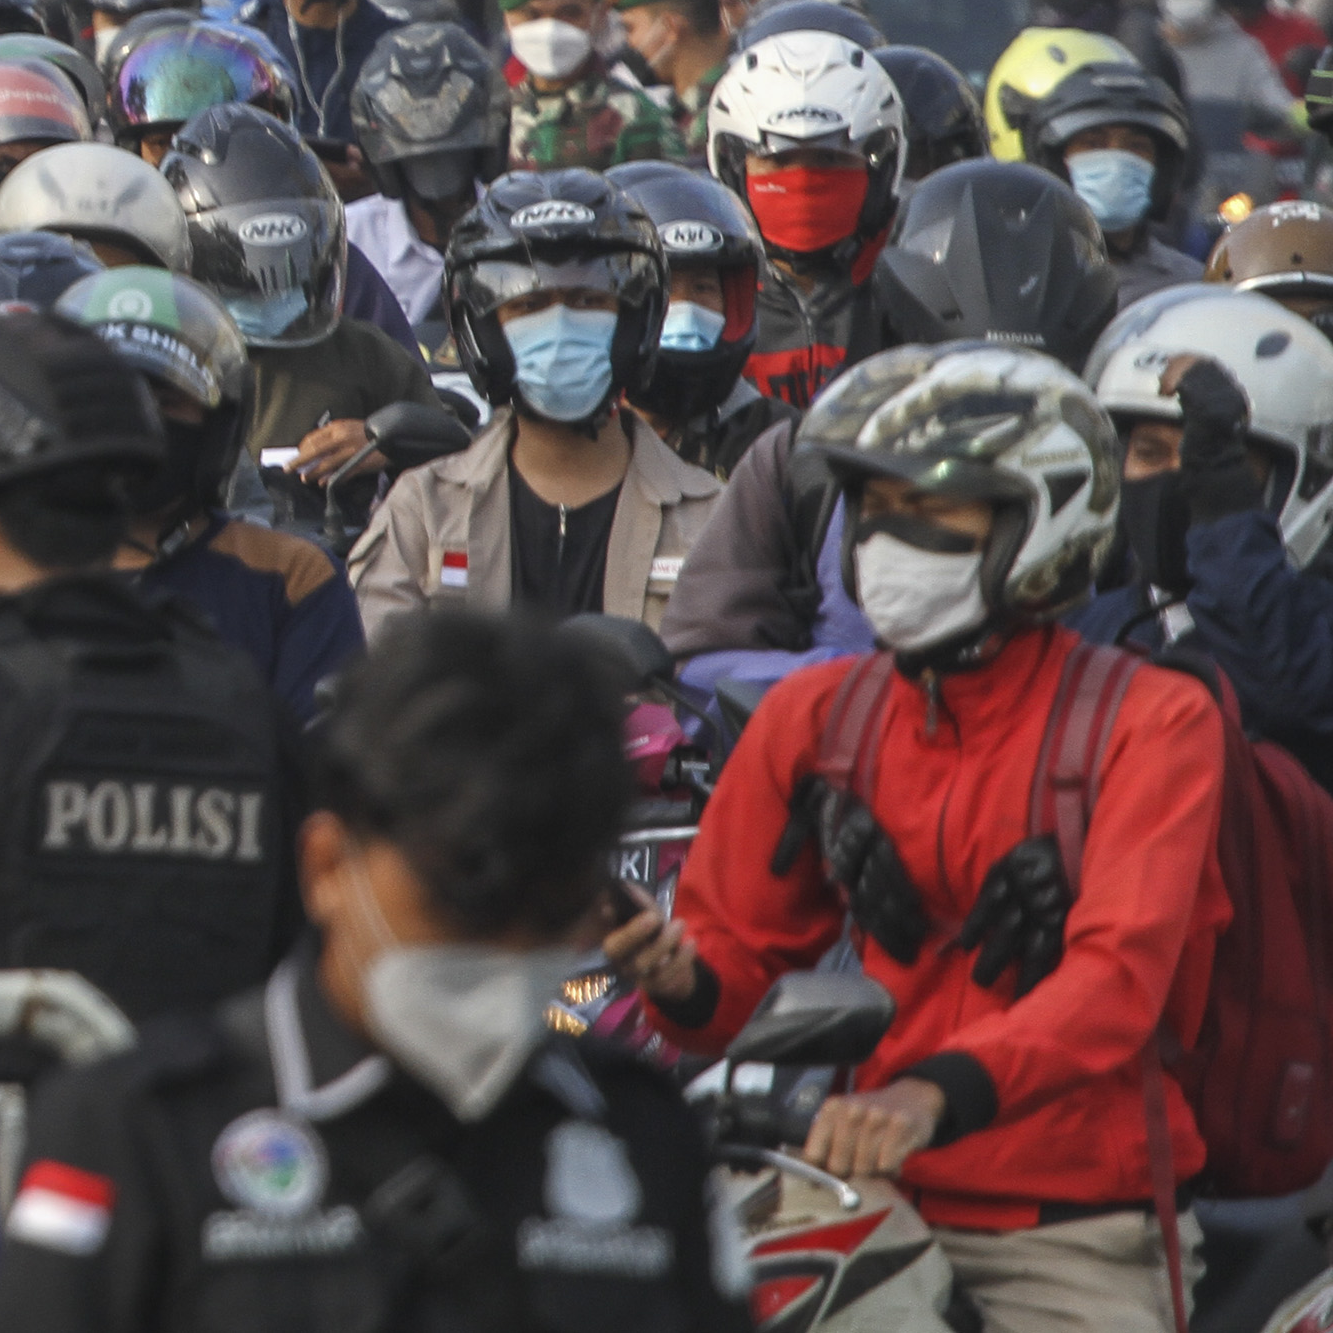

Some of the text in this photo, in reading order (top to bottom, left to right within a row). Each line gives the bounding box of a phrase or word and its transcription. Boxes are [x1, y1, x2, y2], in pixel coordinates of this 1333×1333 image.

[248, 219, 298, 240] NHK
[985, 328, 1045, 347] HONDA
[43, 779, 261, 860] POLISI
